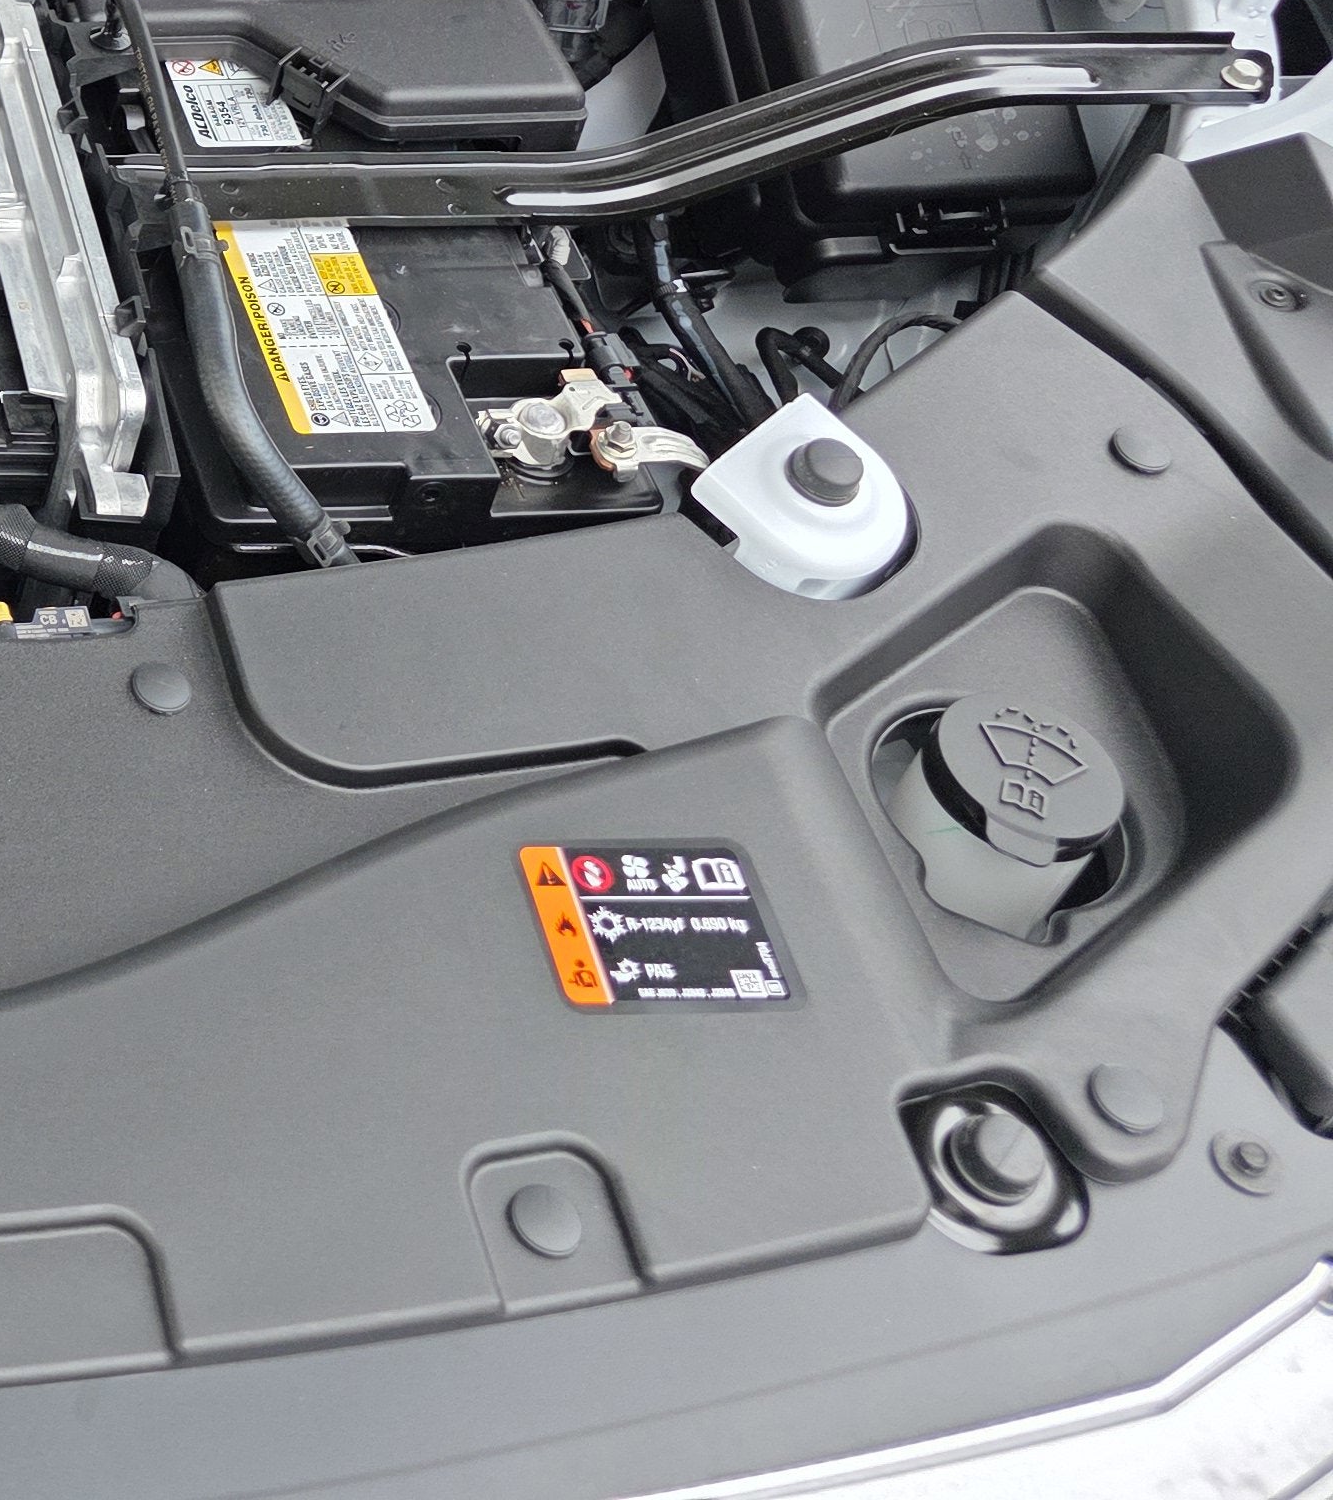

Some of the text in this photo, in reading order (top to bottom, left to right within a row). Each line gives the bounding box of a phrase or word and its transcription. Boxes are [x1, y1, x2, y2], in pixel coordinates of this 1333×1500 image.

[244, 87, 254, 99] 730
[183, 85, 211, 138] ACDelco
[216, 101, 234, 125] 9354
[260, 124, 270, 136] 730
[238, 276, 284, 371] DANGER/POISON
[299, 362, 327, 411] EXPLOSIVE GASES
[39, 614, 58, 625] CB
[626, 879, 660, 892] AUTO
[625, 917, 686, 934] R-1234yf
[727, 917, 750, 934] kg
[644, 963, 676, 979] PAG
